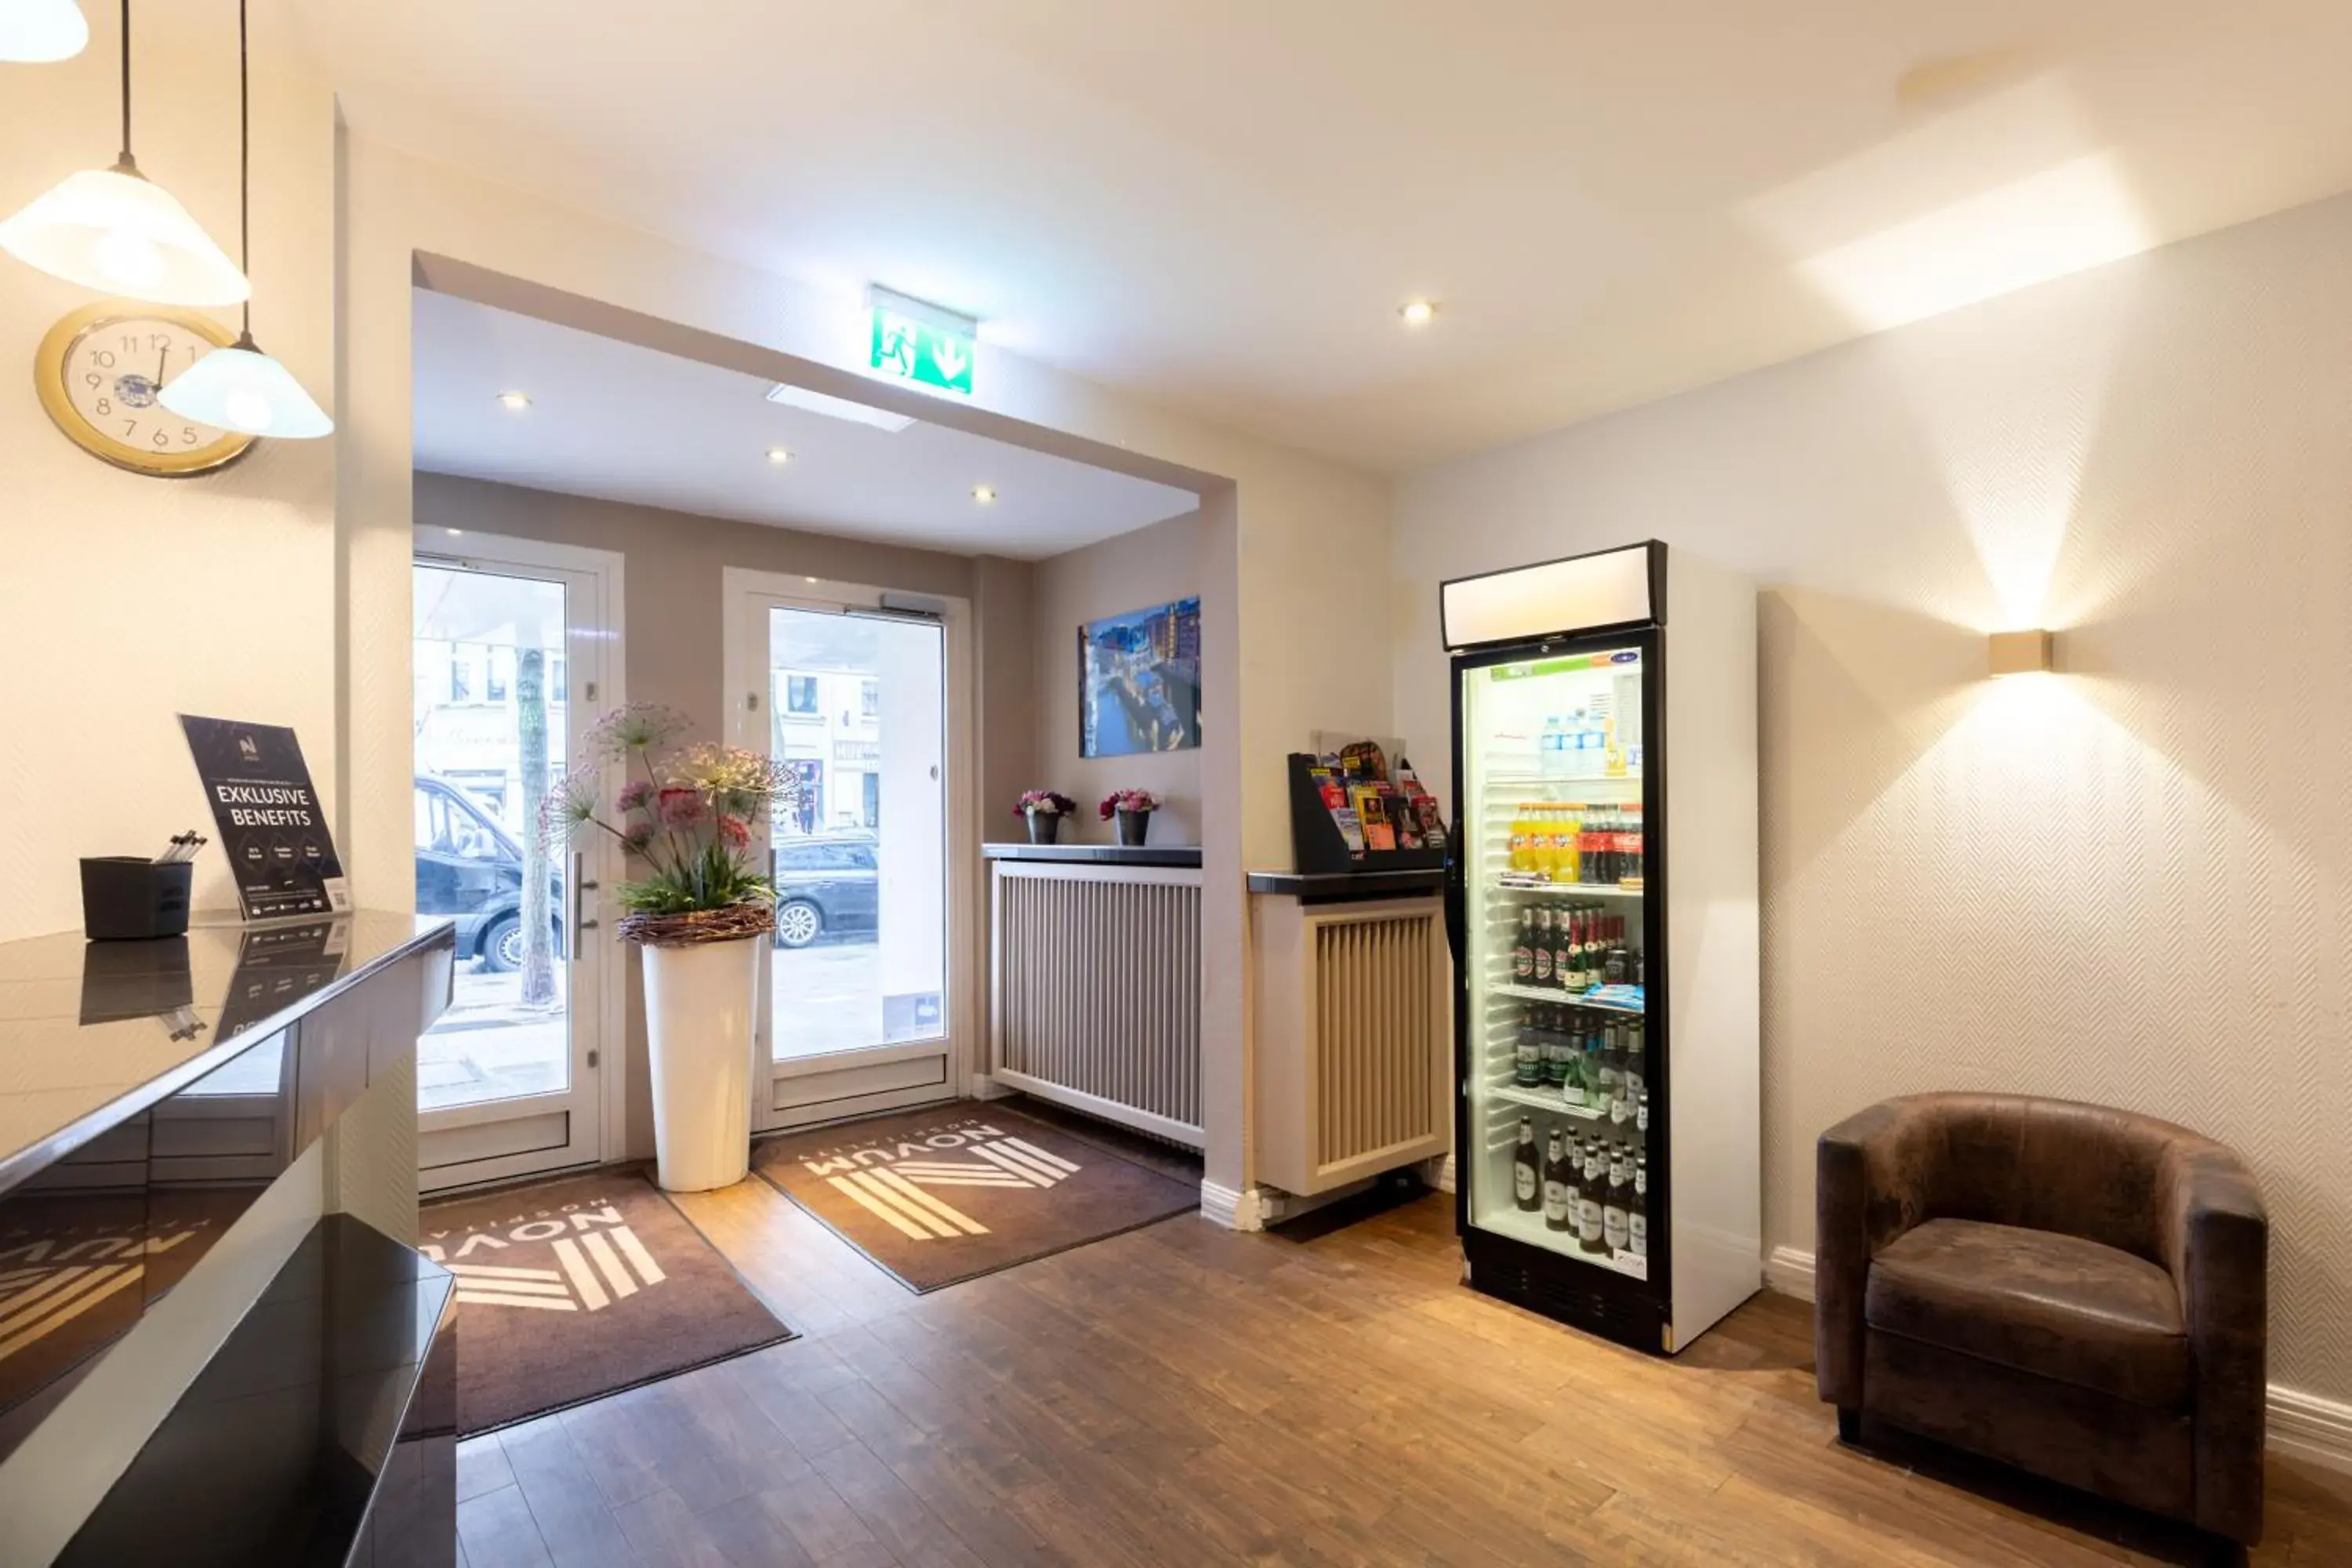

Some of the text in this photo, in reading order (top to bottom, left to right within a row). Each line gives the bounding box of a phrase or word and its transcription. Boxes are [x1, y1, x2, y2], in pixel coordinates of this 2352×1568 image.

[120, 336, 138, 353] 11
[149, 333, 172, 352] 12
[89, 351, 115, 368] 10
[85, 373, 100, 390] 9
[96, 398, 111, 416] 8
[124, 419, 137, 437] 7
[153, 427, 169, 446] 6
[182, 426, 197, 444] 5
[216, 786, 310, 805] EXKLUSIVE
[230, 808, 311, 826] BENEFITS
[804, 1125, 1005, 1176] NOVUM
